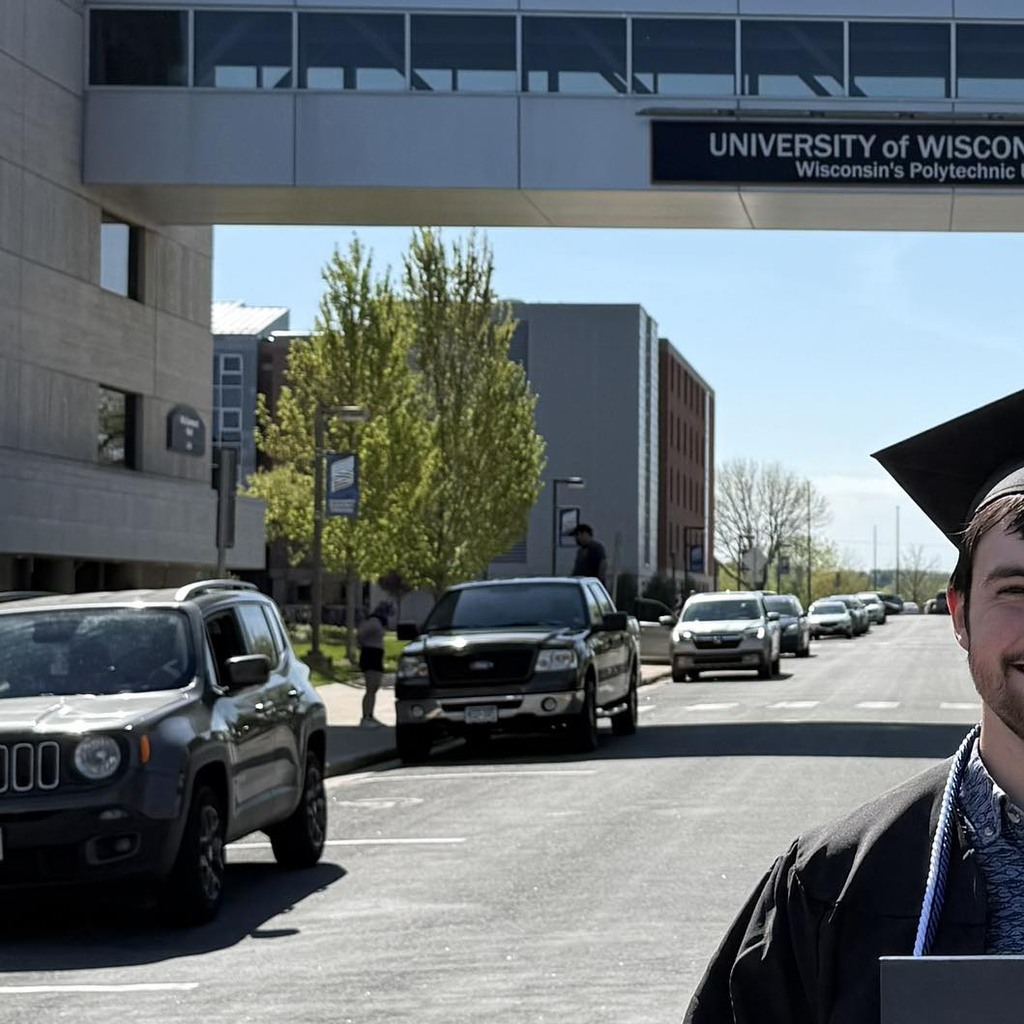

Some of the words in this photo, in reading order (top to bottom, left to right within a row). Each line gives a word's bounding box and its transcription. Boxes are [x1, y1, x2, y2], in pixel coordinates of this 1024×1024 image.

[709, 132, 877, 158] UNIVERSITY
[882, 134, 910, 159] of
[795, 160, 905, 179] Wisconsin's
[910, 161, 1016, 182] Polytechnic
